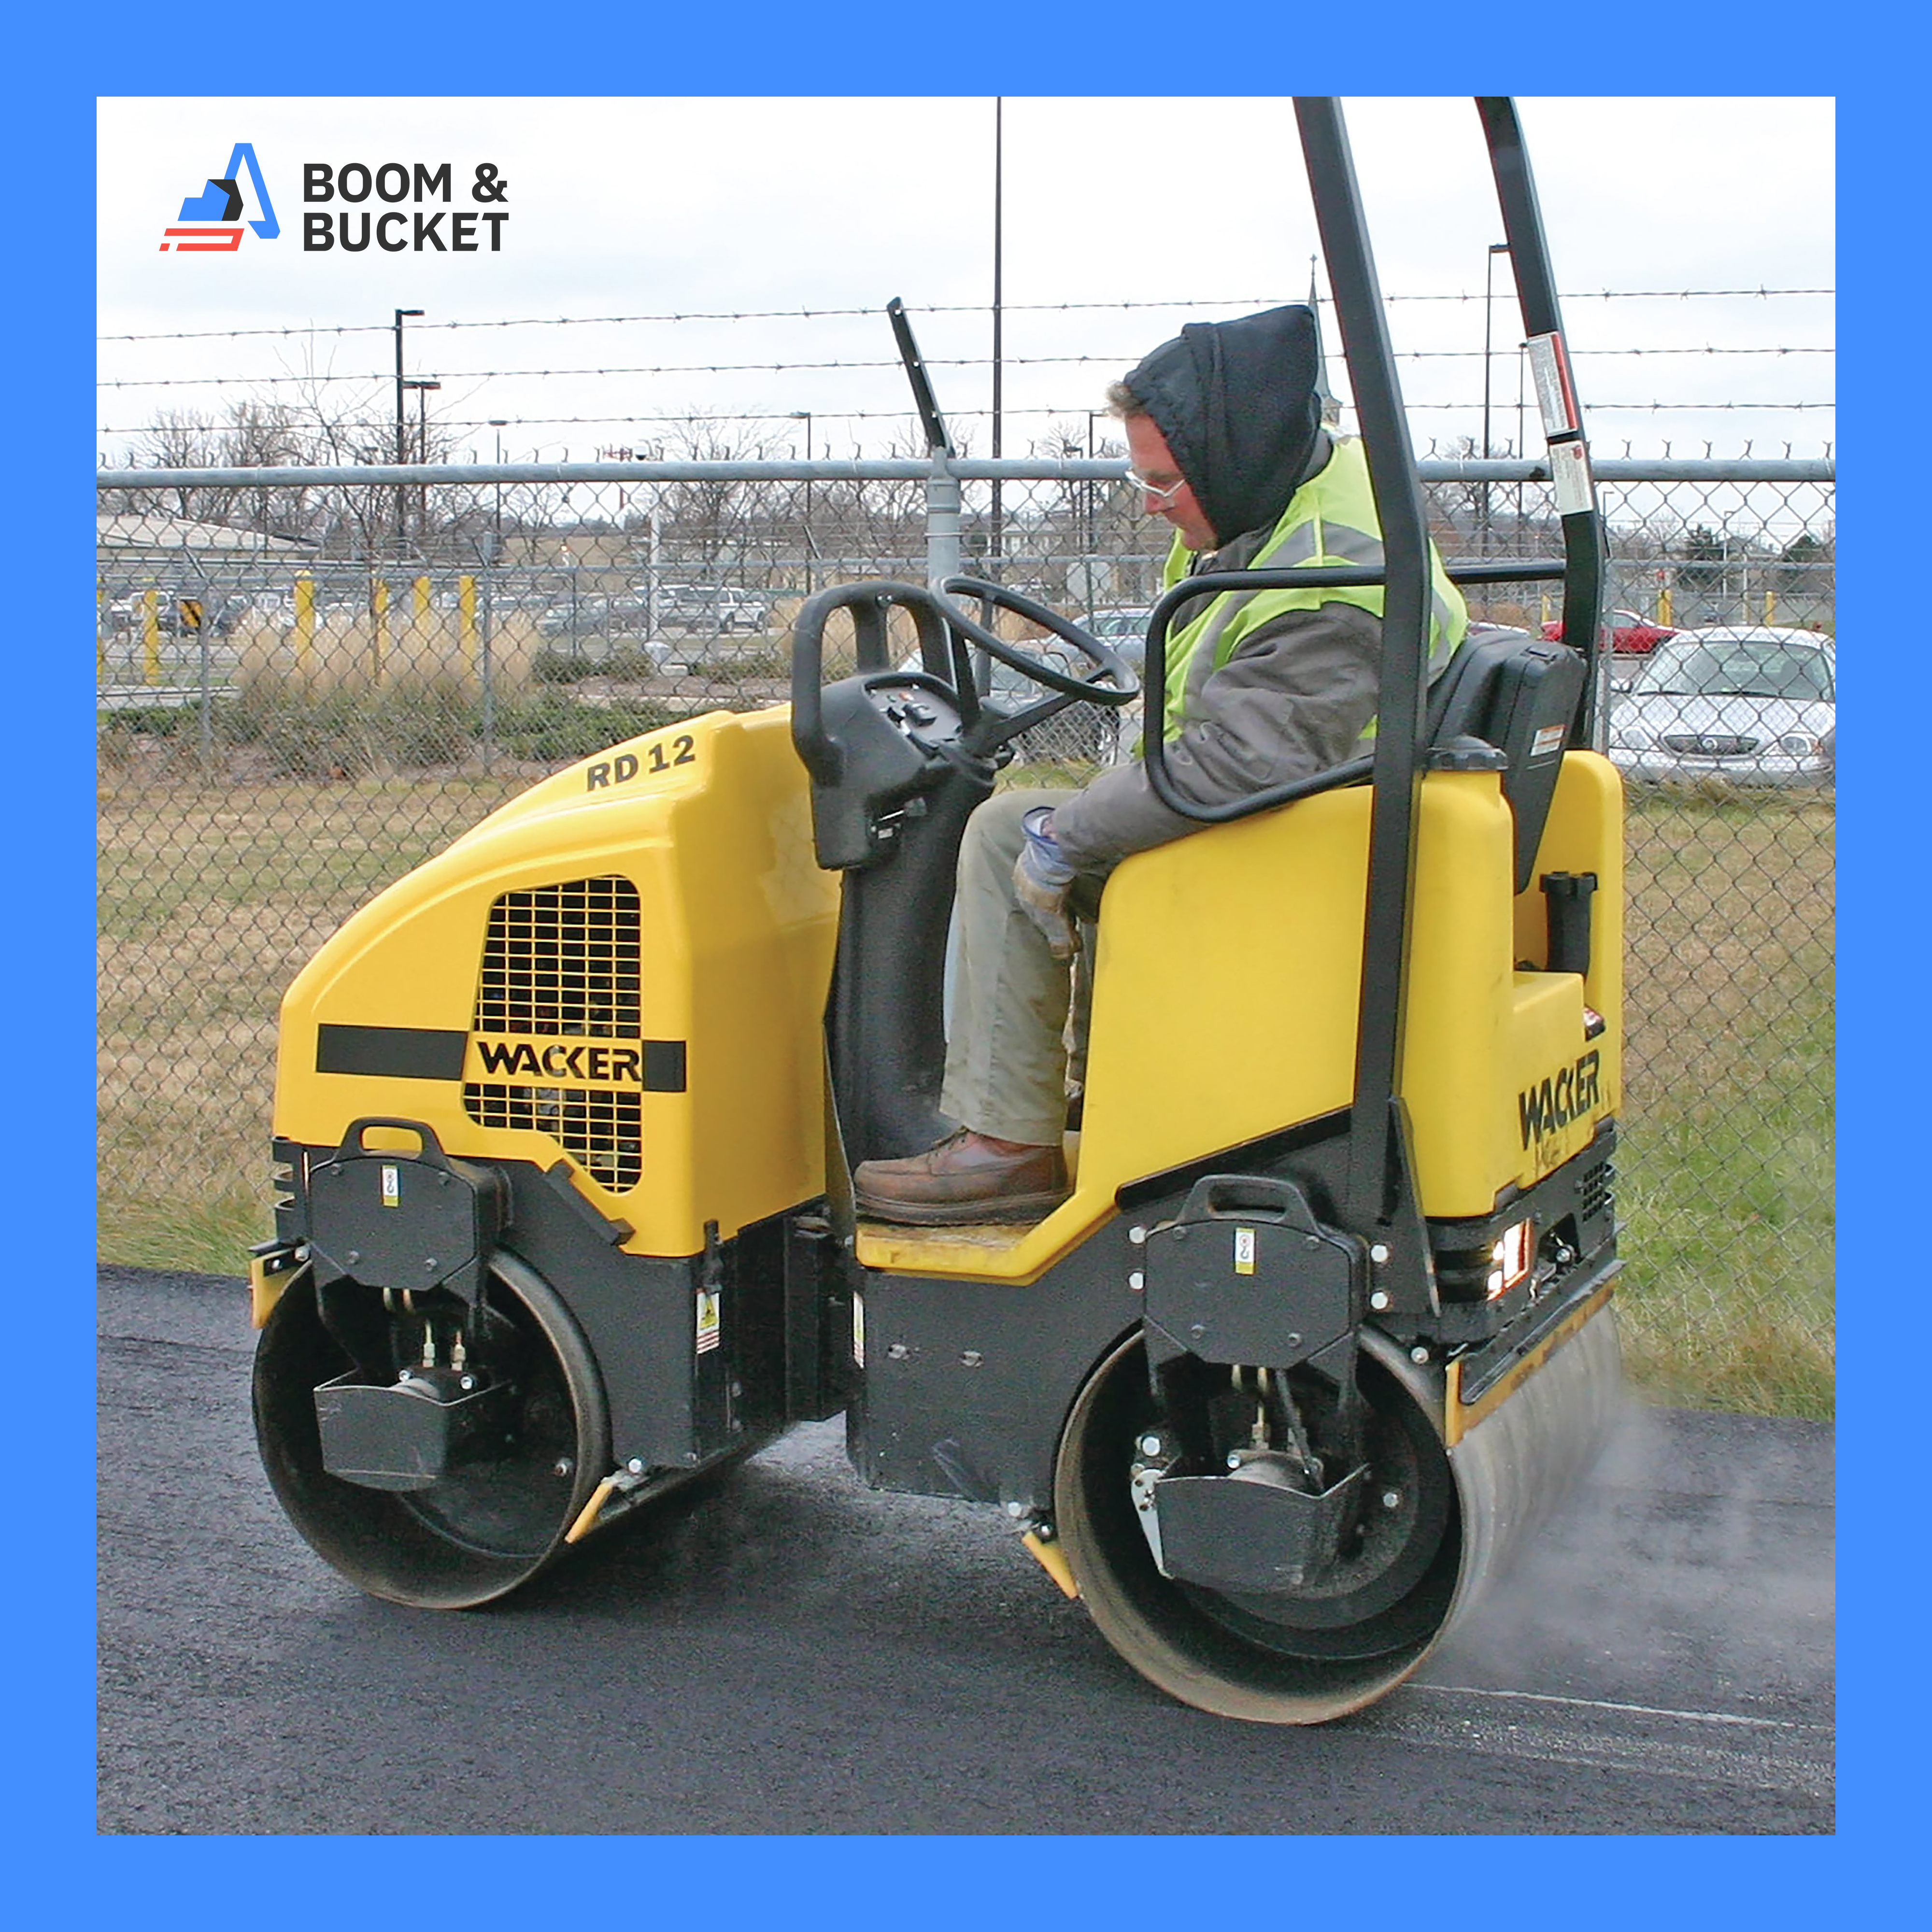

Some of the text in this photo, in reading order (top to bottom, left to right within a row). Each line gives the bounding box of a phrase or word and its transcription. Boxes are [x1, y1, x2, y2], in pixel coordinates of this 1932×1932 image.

[587, 735, 696, 792] RD 12
[476, 1041, 642, 1082] WACKER
[1518, 1049, 1600, 1152] WACKER
